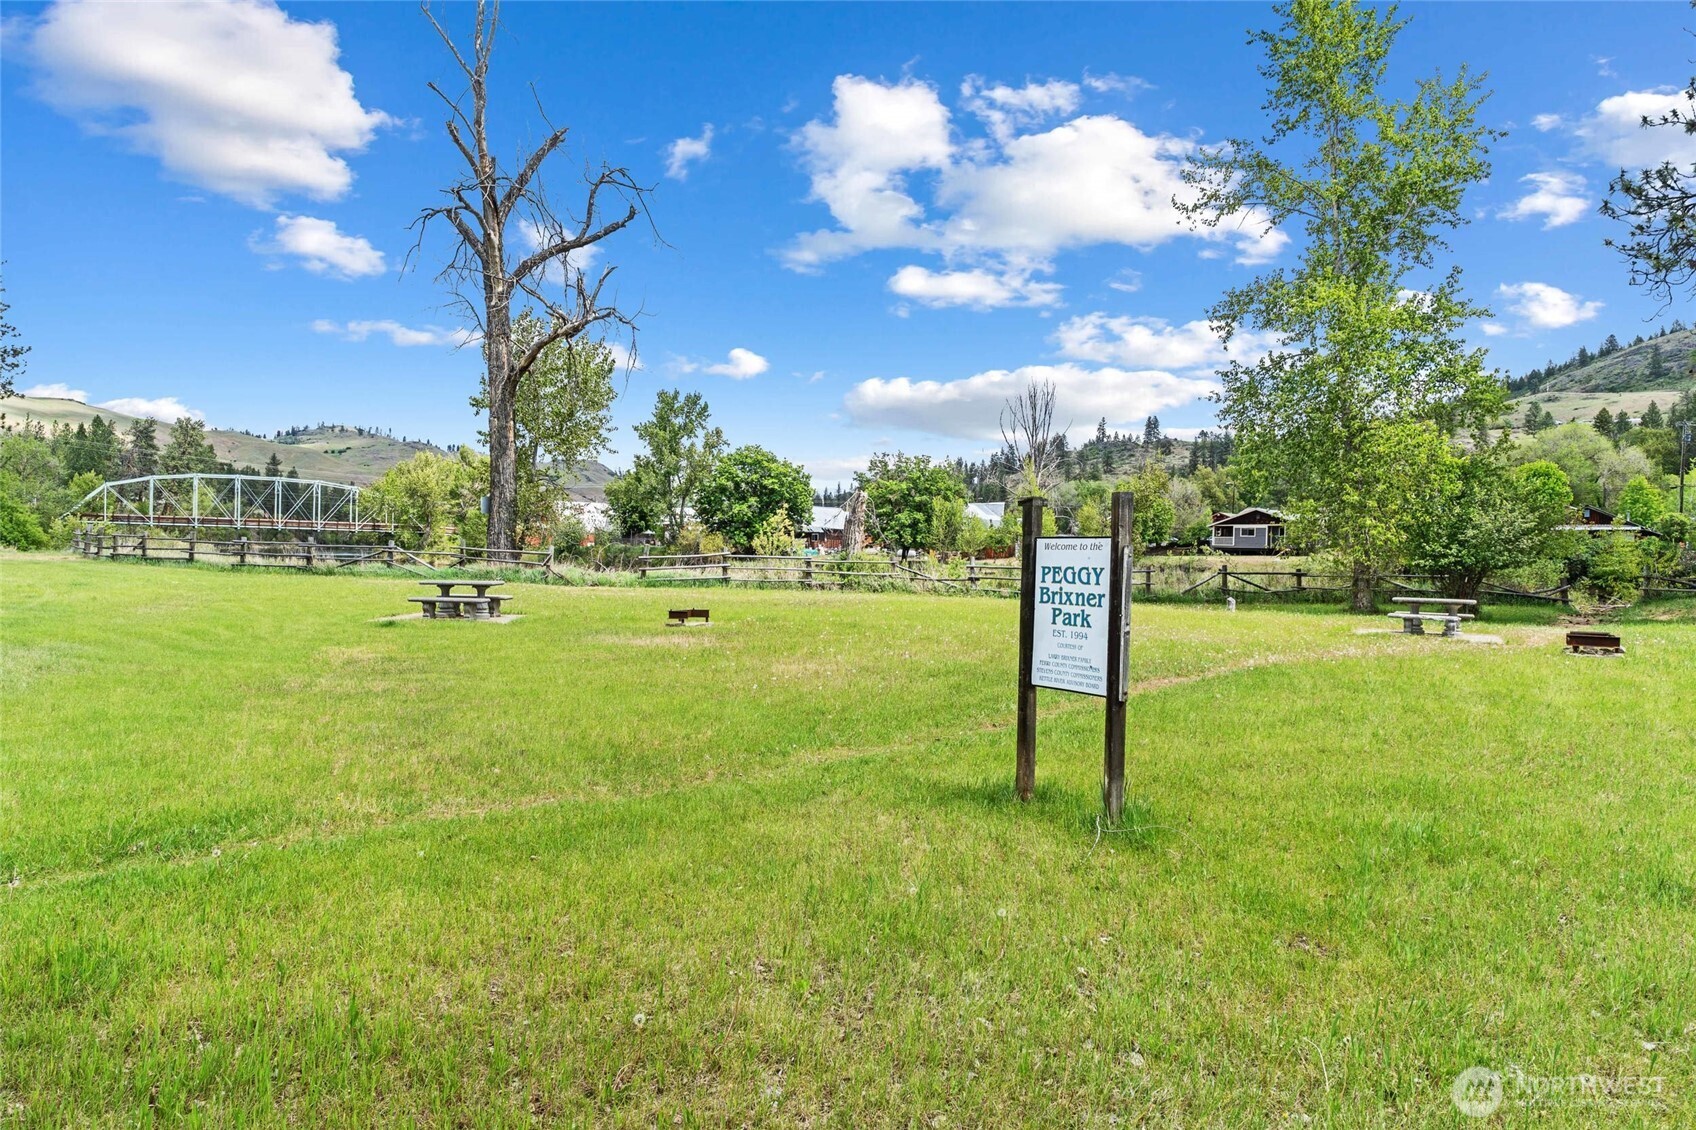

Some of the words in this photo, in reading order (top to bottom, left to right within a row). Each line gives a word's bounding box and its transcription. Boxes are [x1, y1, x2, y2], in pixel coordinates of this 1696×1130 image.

[1044, 542, 1078, 551] Welcome
[1079, 543, 1087, 551] to
[1089, 542, 1103, 551] the
[1040, 566, 1105, 586] PEGGY
[1039, 586, 1105, 608] Brixner
[1051, 607, 1092, 628] Park
[1052, 629, 1067, 639] EST.
[1070, 631, 1088, 640] 1994
[1036, 667, 1053, 675] STEVENS
[1054, 669, 1070, 677] COUNTY
[1070, 671, 1103, 682] COMMISSIONERS
[1066, 679, 1085, 687] ADVISORY
[1085, 682, 1100, 690] BOARD
